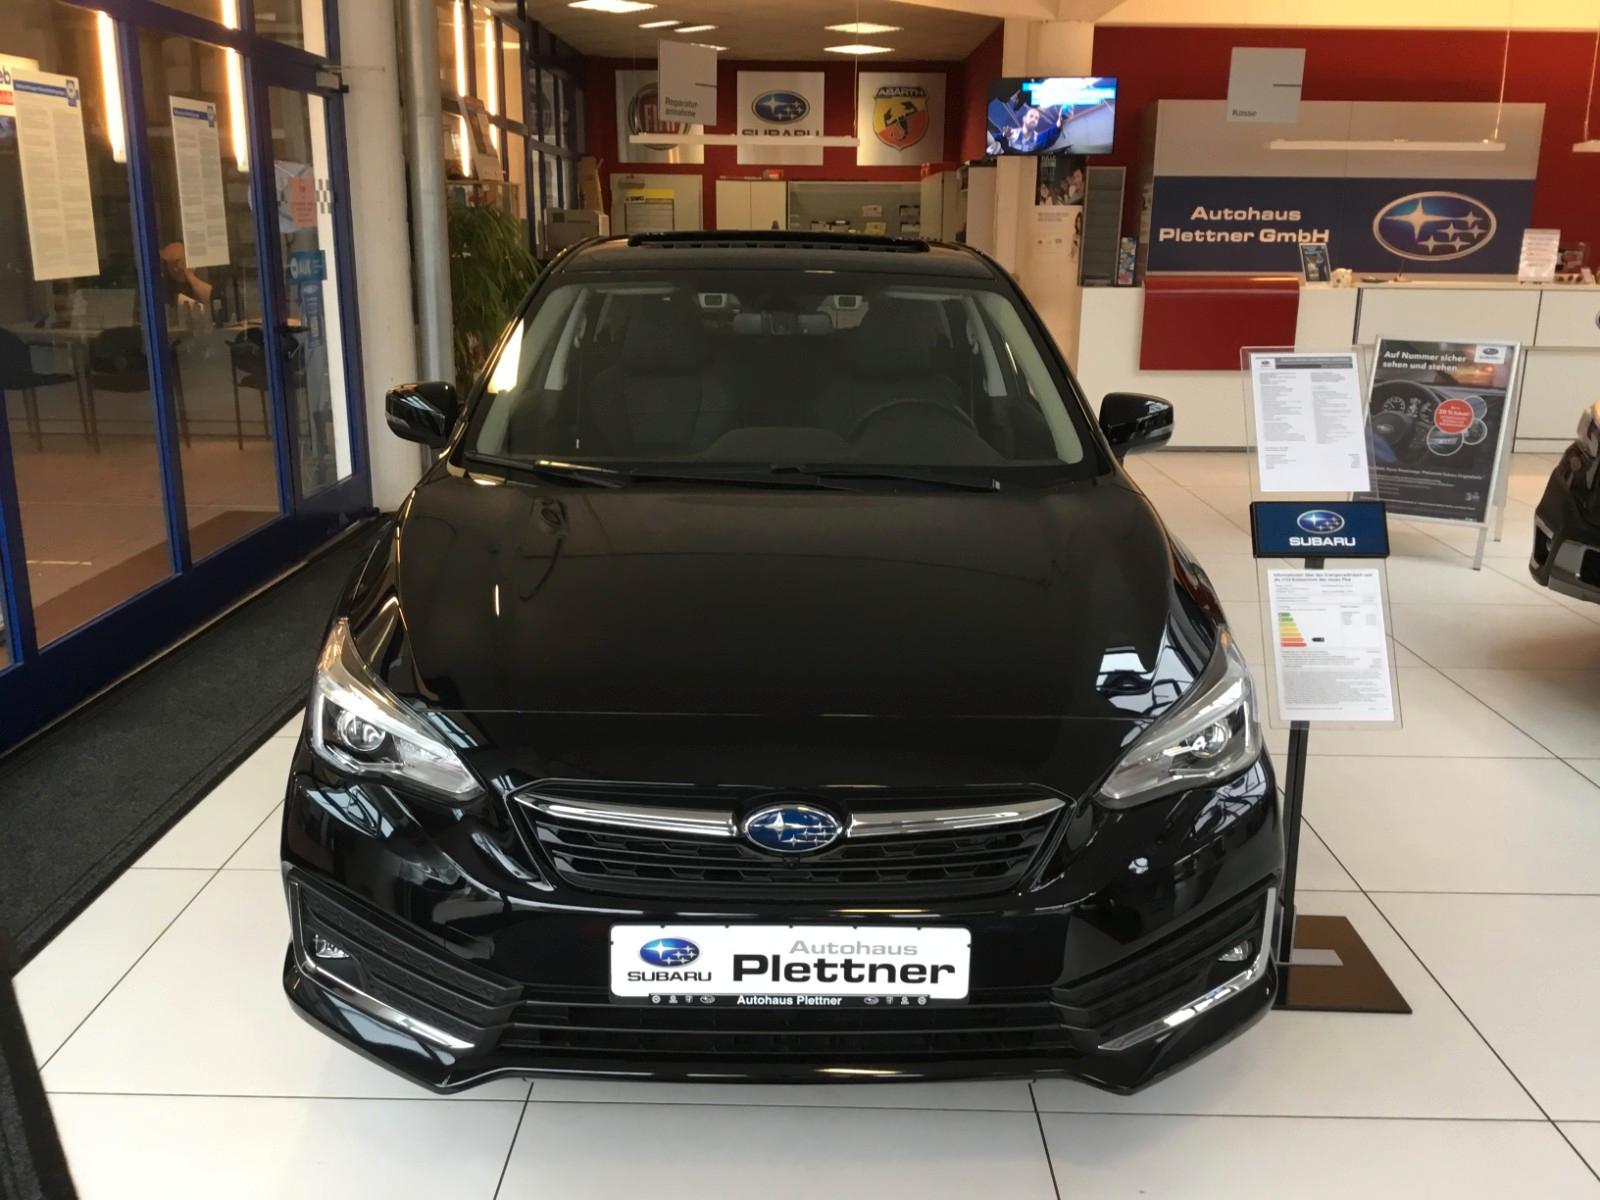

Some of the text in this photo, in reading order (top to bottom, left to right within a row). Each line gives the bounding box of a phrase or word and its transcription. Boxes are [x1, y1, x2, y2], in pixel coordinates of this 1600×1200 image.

[879, 88, 923, 97] ABARTH
[1190, 206, 1302, 221] Autohaus
[1158, 227, 1330, 244] Plettner GmbH
[1384, 350, 1467, 363] Auf Nummer sicher
[1409, 362, 1426, 370] und
[1289, 536, 1356, 547] SUBARU
[789, 940, 918, 956] Autohaus
[627, 954, 956, 984] SUBARU Plettner
[736, 995, 843, 1006] Autohaus Plettner
